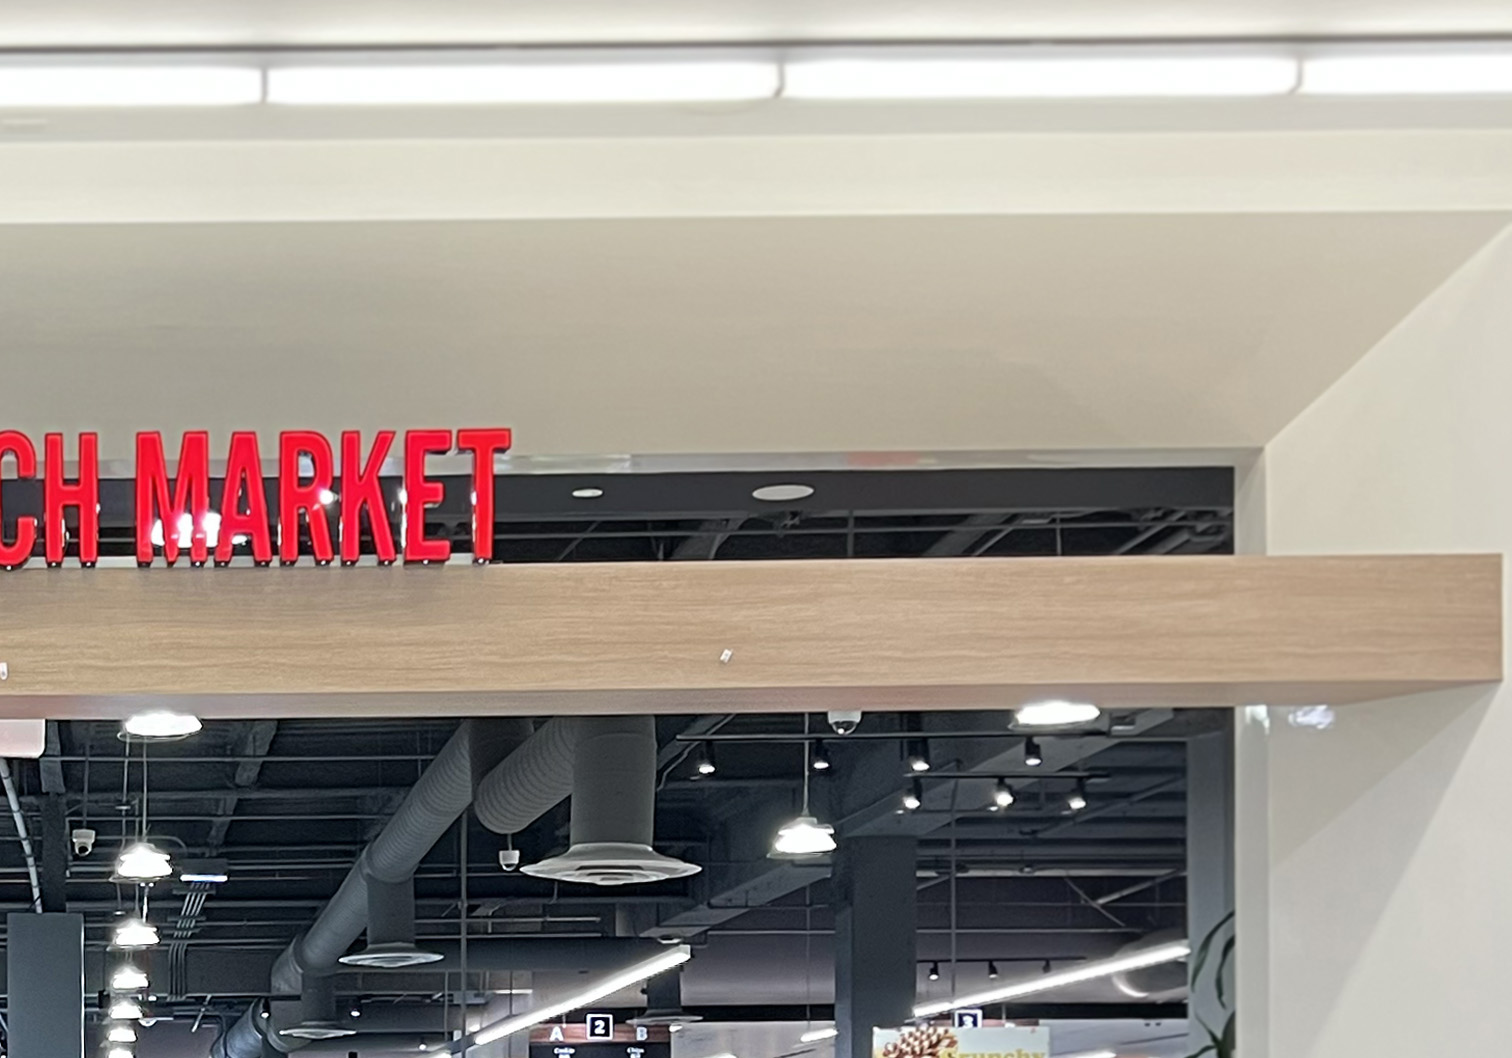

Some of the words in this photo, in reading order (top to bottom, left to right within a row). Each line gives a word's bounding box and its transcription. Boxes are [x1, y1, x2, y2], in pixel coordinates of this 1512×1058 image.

[136, 428, 512, 566] MARKET
[549, 1026, 564, 1042] A
[594, 1019, 606, 1035] 2
[636, 1027, 648, 1041] B
